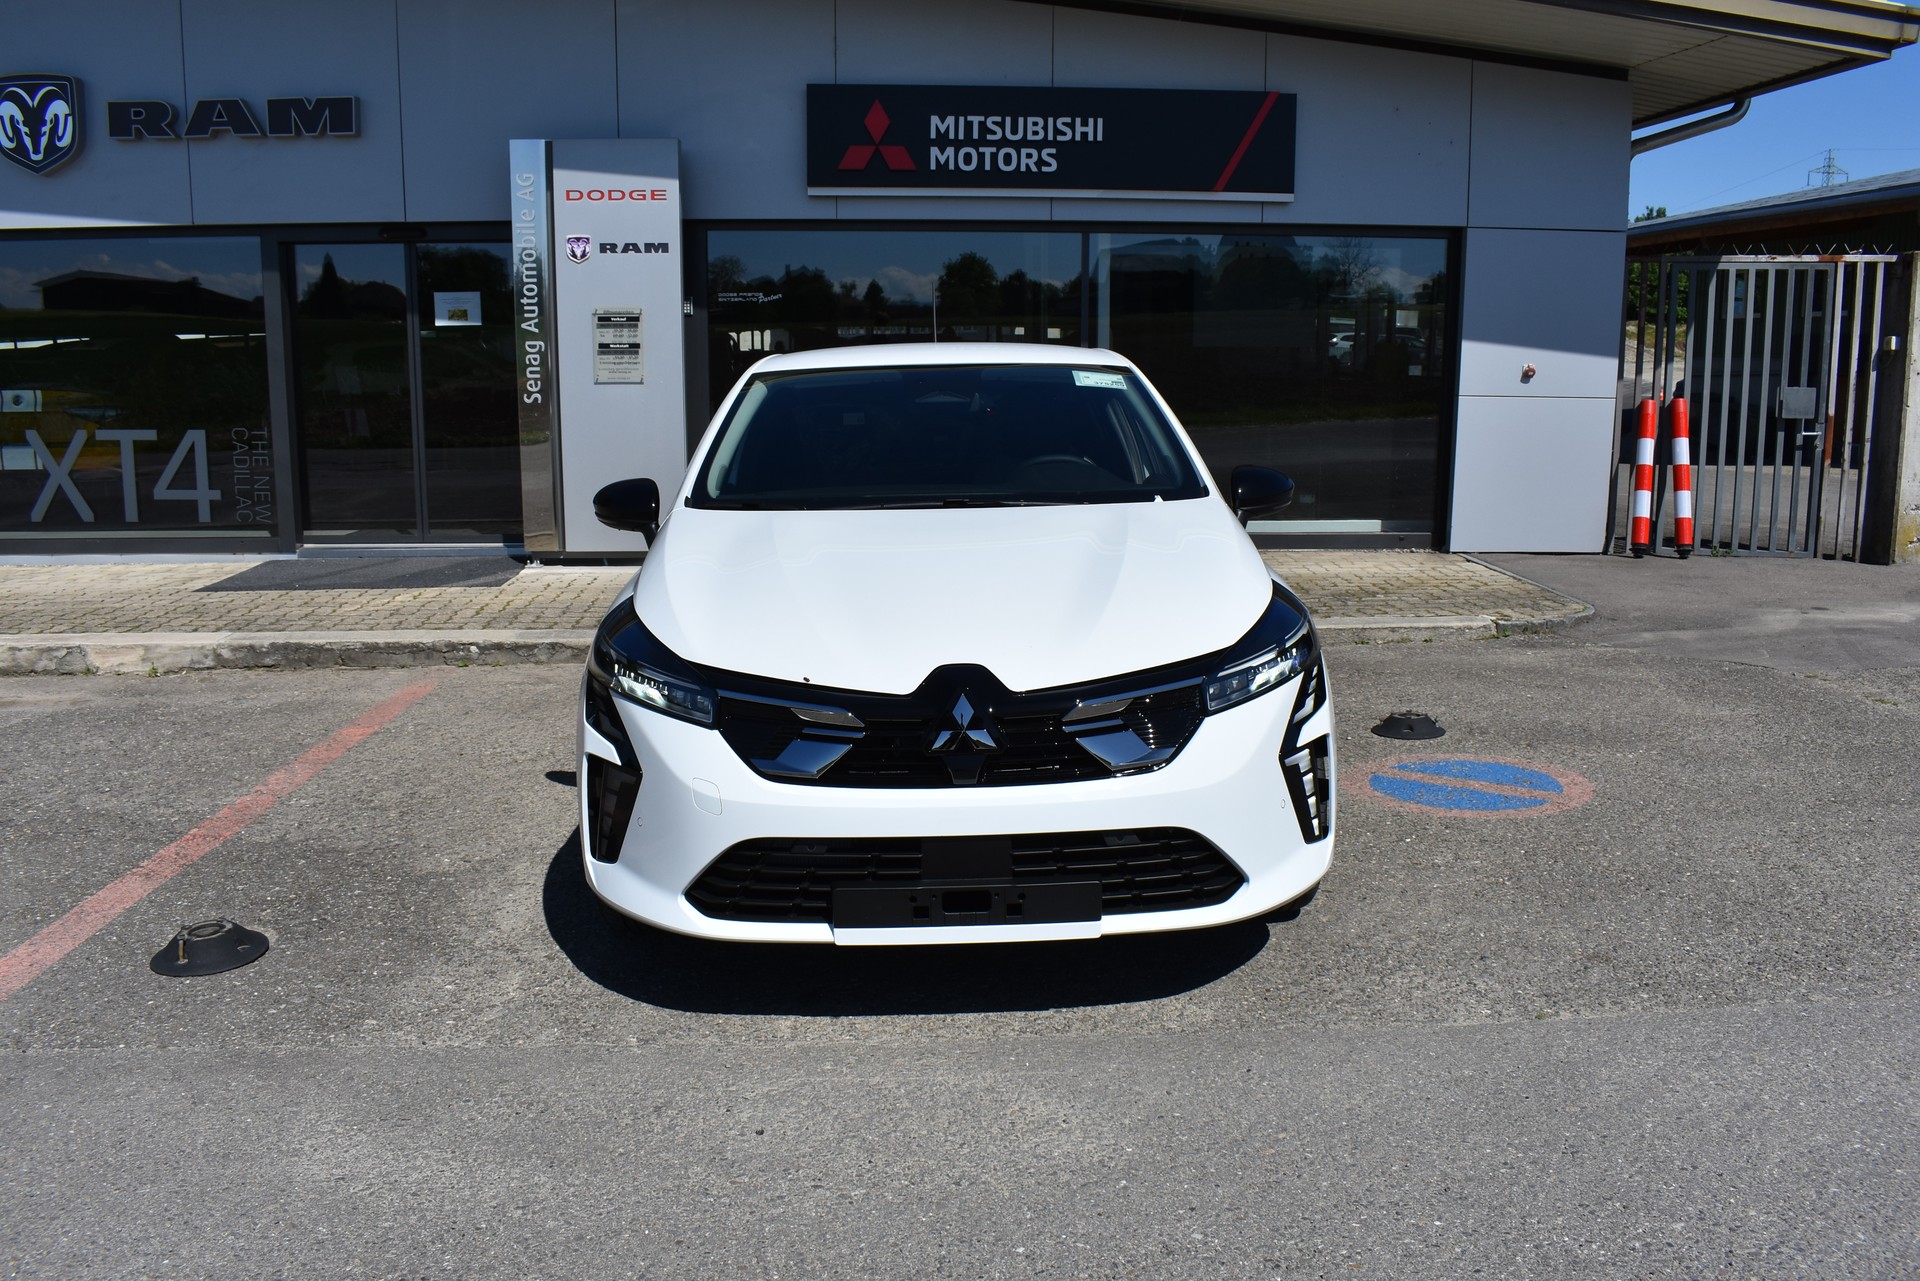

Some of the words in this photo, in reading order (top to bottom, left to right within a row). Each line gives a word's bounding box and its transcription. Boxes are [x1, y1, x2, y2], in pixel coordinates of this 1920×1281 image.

[107, 96, 359, 139] RAM
[929, 114, 1104, 142] MITSUBISHI
[929, 146, 1058, 173] MOTORS
[515, 172, 535, 203] AG
[565, 189, 668, 202] DODGE
[599, 242, 670, 254] RAM
[515, 208, 540, 333] Automobile
[523, 340, 545, 404] Senag
[250, 427, 269, 467] THE
[25, 429, 222, 523] XT4
[231, 427, 253, 523] CADILLAC
[254, 476, 273, 524] NEW
